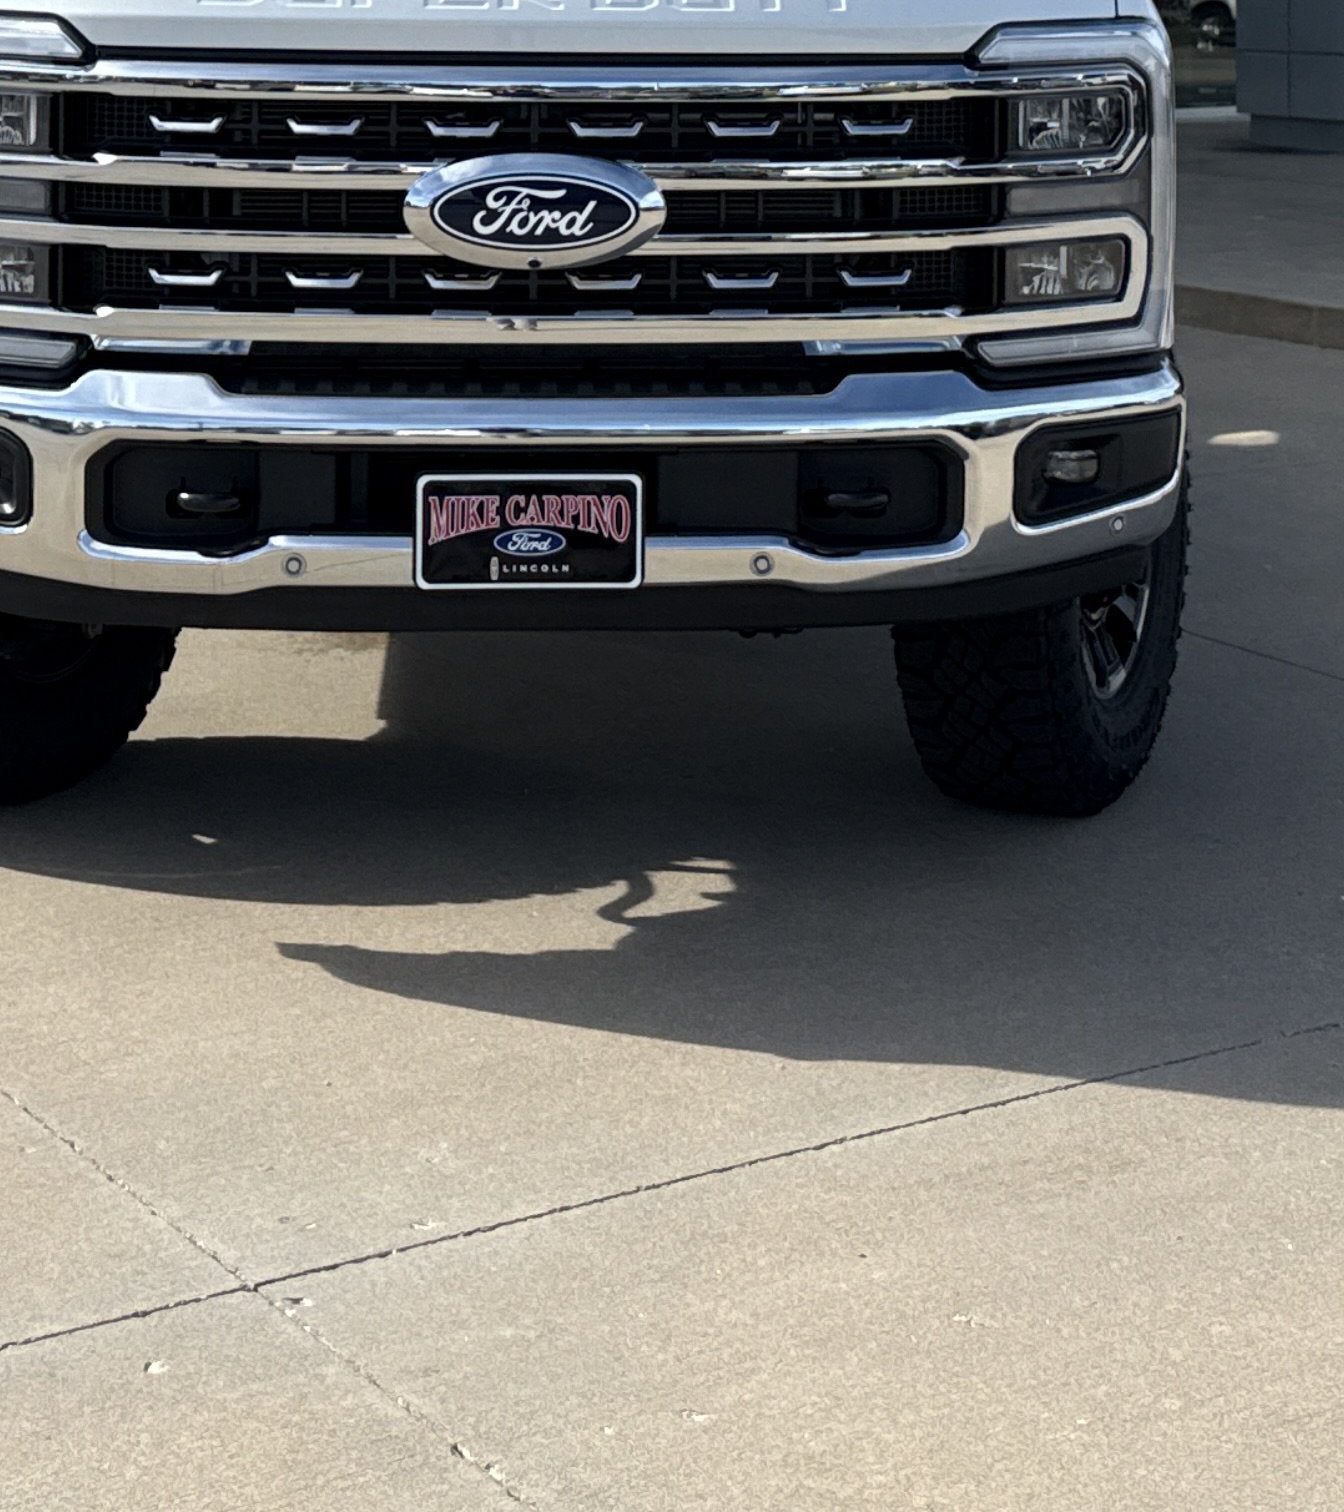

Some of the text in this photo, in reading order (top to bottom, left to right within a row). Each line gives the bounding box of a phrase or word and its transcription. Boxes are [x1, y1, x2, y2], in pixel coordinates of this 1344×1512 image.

[472, 185, 598, 236] Ford
[428, 494, 632, 546] MIKE CARPINO
[506, 532, 553, 551] Ford
[502, 563, 570, 574] LINCOLN
